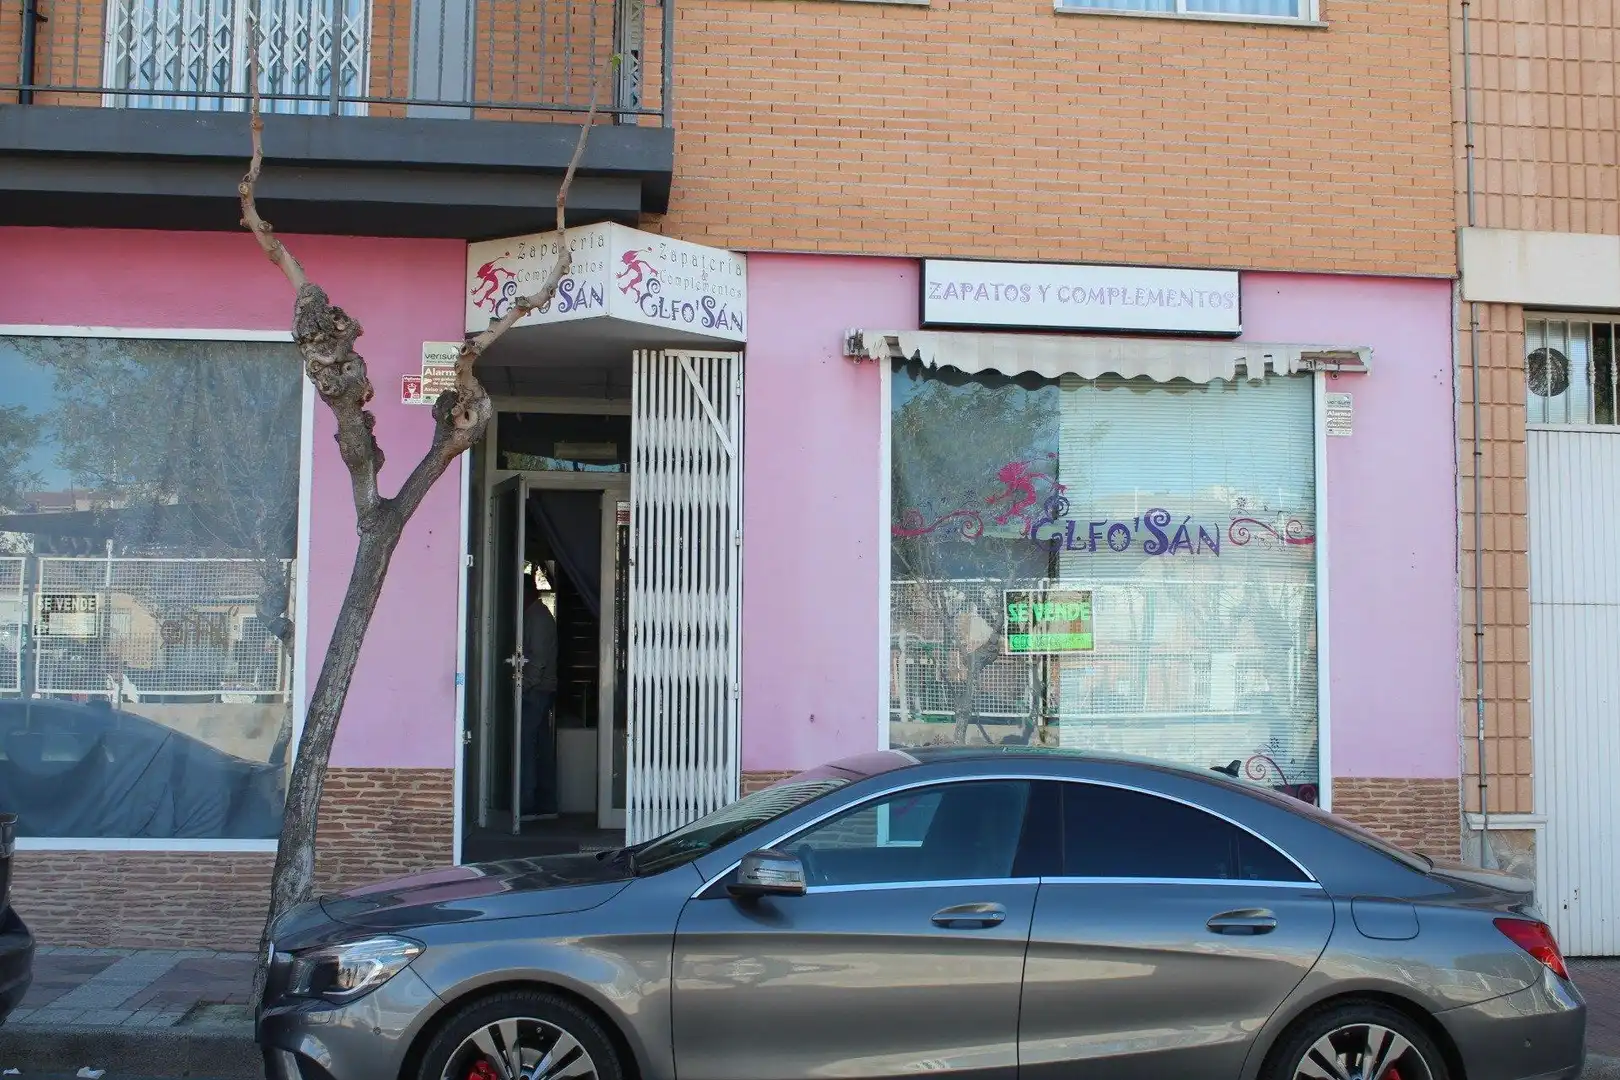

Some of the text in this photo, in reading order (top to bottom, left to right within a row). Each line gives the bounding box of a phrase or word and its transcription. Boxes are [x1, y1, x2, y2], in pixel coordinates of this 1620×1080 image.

[517, 231, 605, 260] Zapaería
[659, 242, 742, 277] Zapatería
[517, 260, 604, 283] Complentos
[659, 268, 742, 299] Complementos
[638, 277, 744, 333] ELFO'SÁN
[929, 281, 1238, 309] ZAPATOS Y COMPLEMENTOS
[424, 368, 457, 376] Alarm
[1031, 495, 1220, 557] ELFO'SÁN
[38, 598, 96, 611] SE VENDE
[1008, 602, 1091, 622] SE VENDE
